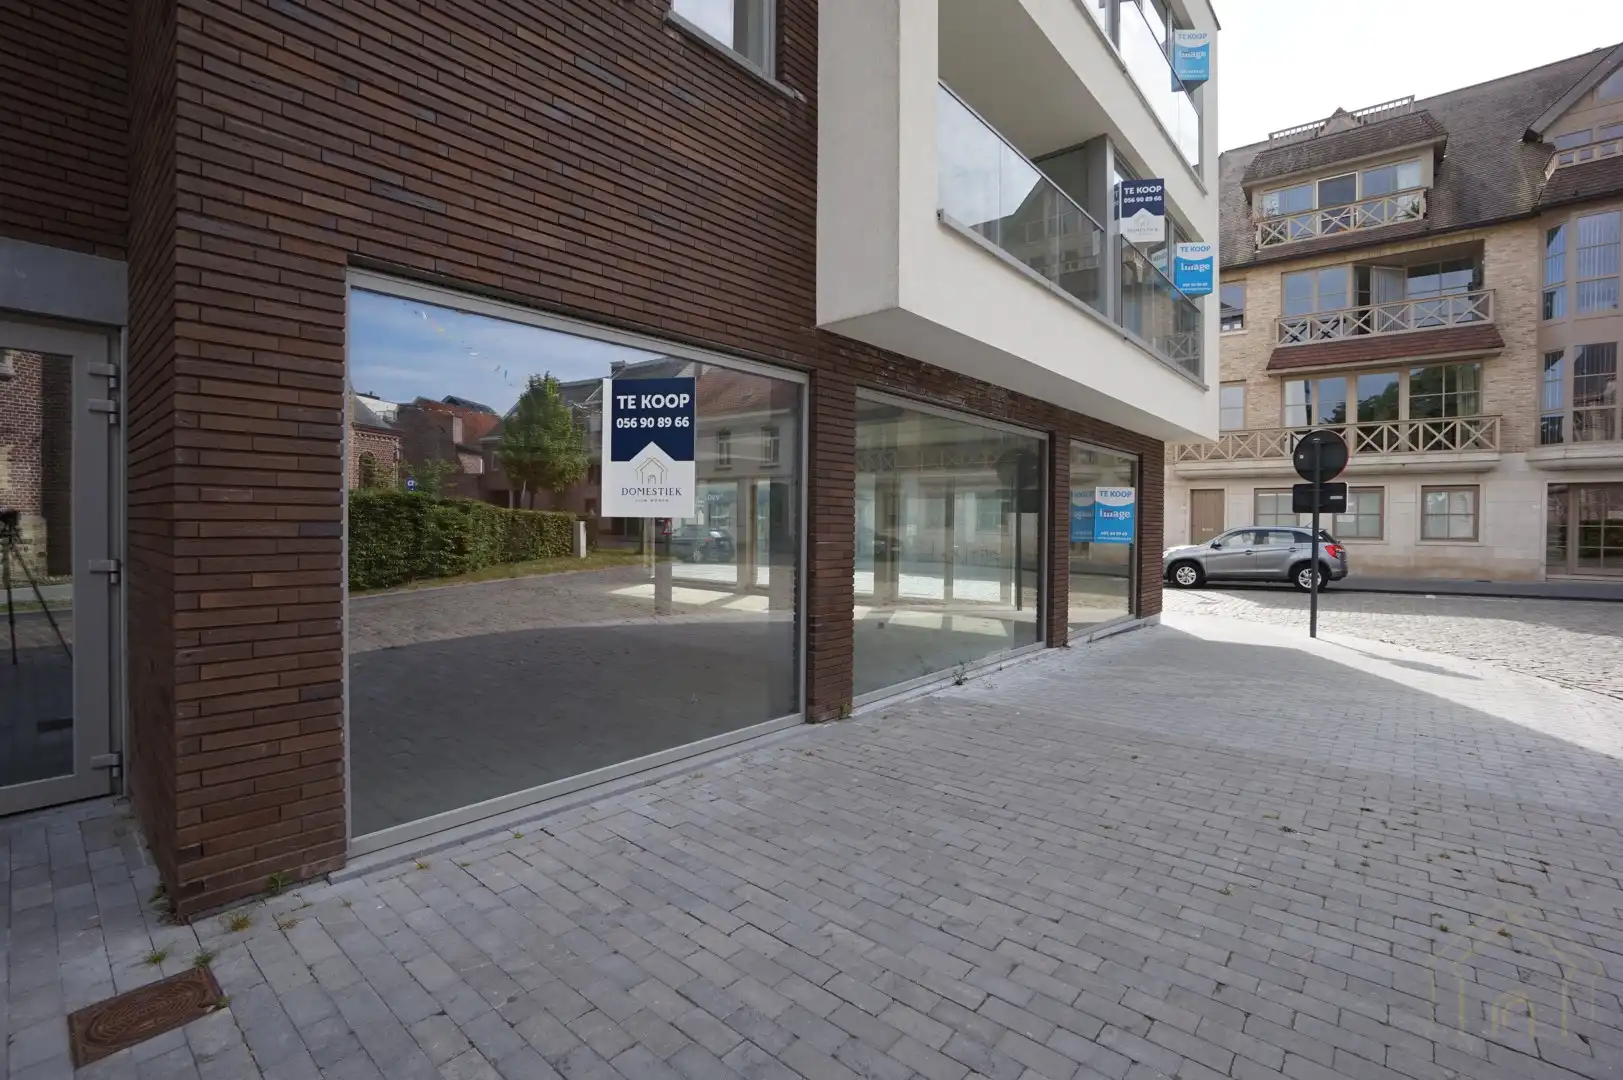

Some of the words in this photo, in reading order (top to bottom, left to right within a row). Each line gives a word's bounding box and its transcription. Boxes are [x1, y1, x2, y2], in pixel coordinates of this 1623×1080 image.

[1136, 185, 1162, 194] KOOP
[616, 395, 636, 409] TE
[641, 393, 690, 409] KOOP
[616, 417, 637, 428] 056
[639, 417, 654, 428] 90
[657, 416, 672, 428] 89
[674, 416, 690, 428] 66
[621, 487, 682, 496] DOMESTIEK
[1110, 490, 1132, 498] KOOP
